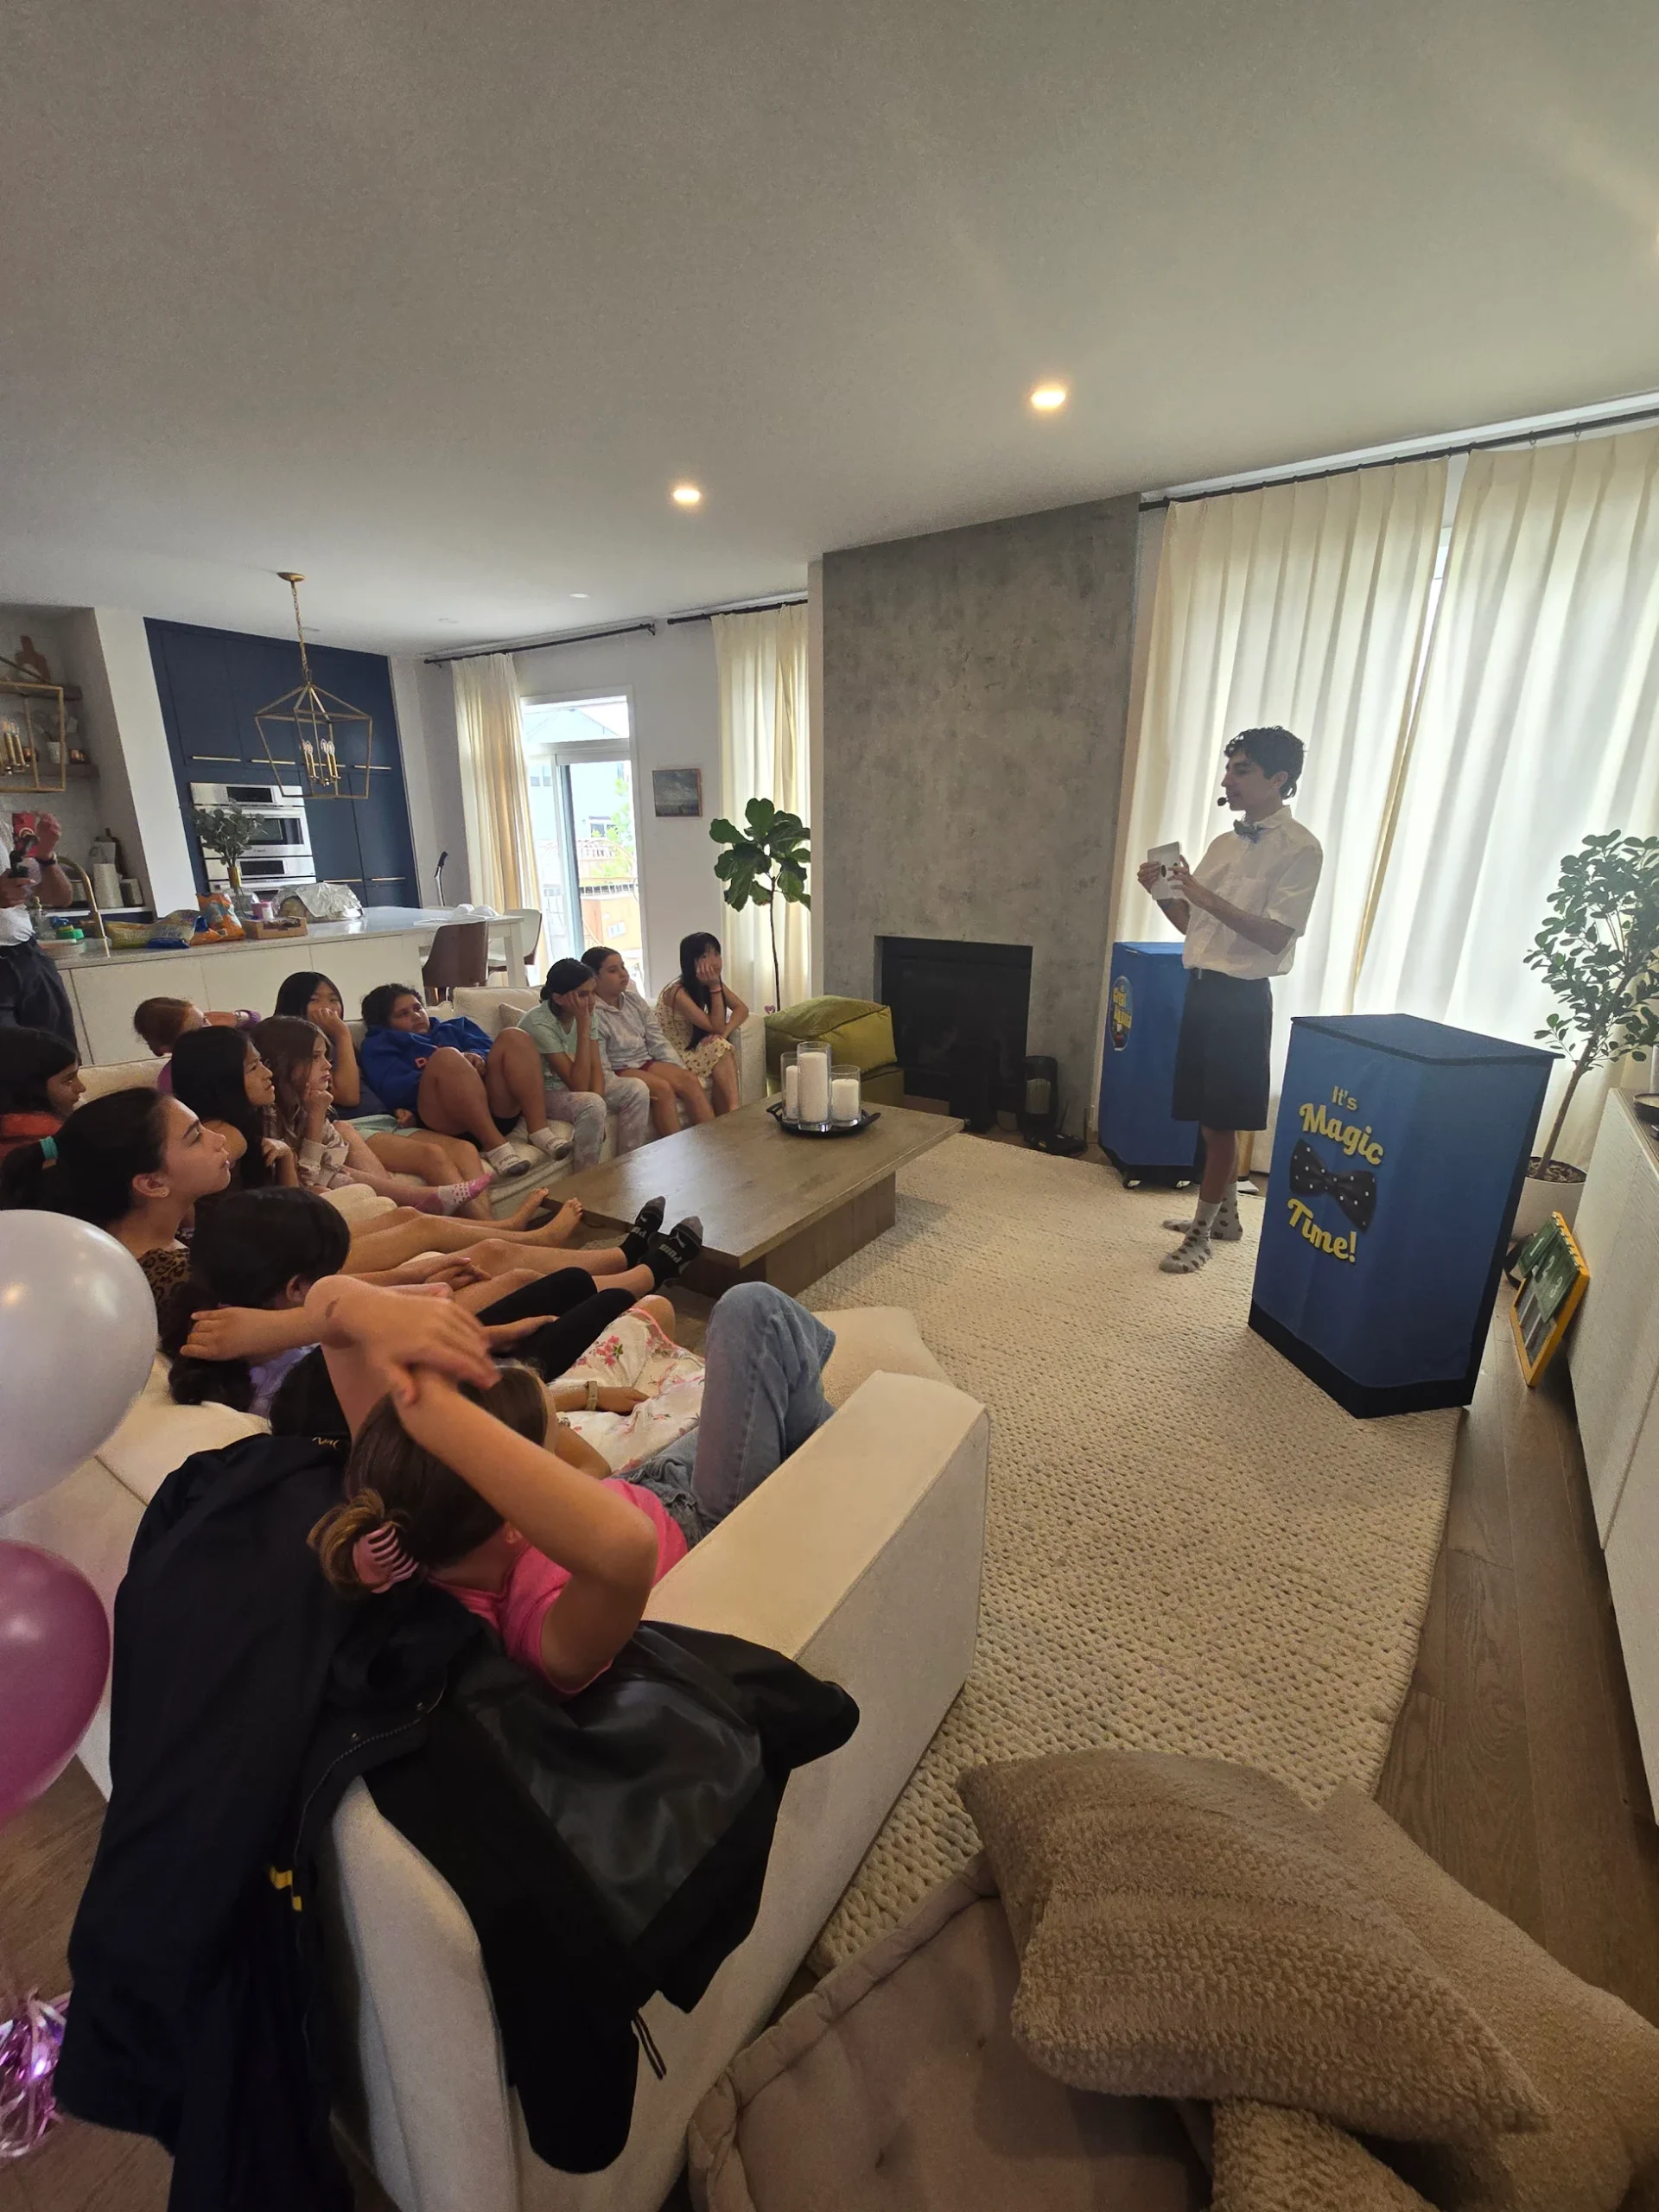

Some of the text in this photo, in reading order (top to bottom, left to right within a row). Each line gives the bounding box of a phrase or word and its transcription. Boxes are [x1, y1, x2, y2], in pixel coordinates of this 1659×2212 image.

[1332, 1085, 1358, 1111] It's
[1299, 1103, 1383, 1166] Magic
[1287, 1198, 1357, 1263] Time!
[1541, 1255, 1555, 1279] 2
[1549, 1275, 1563, 1299] 3
